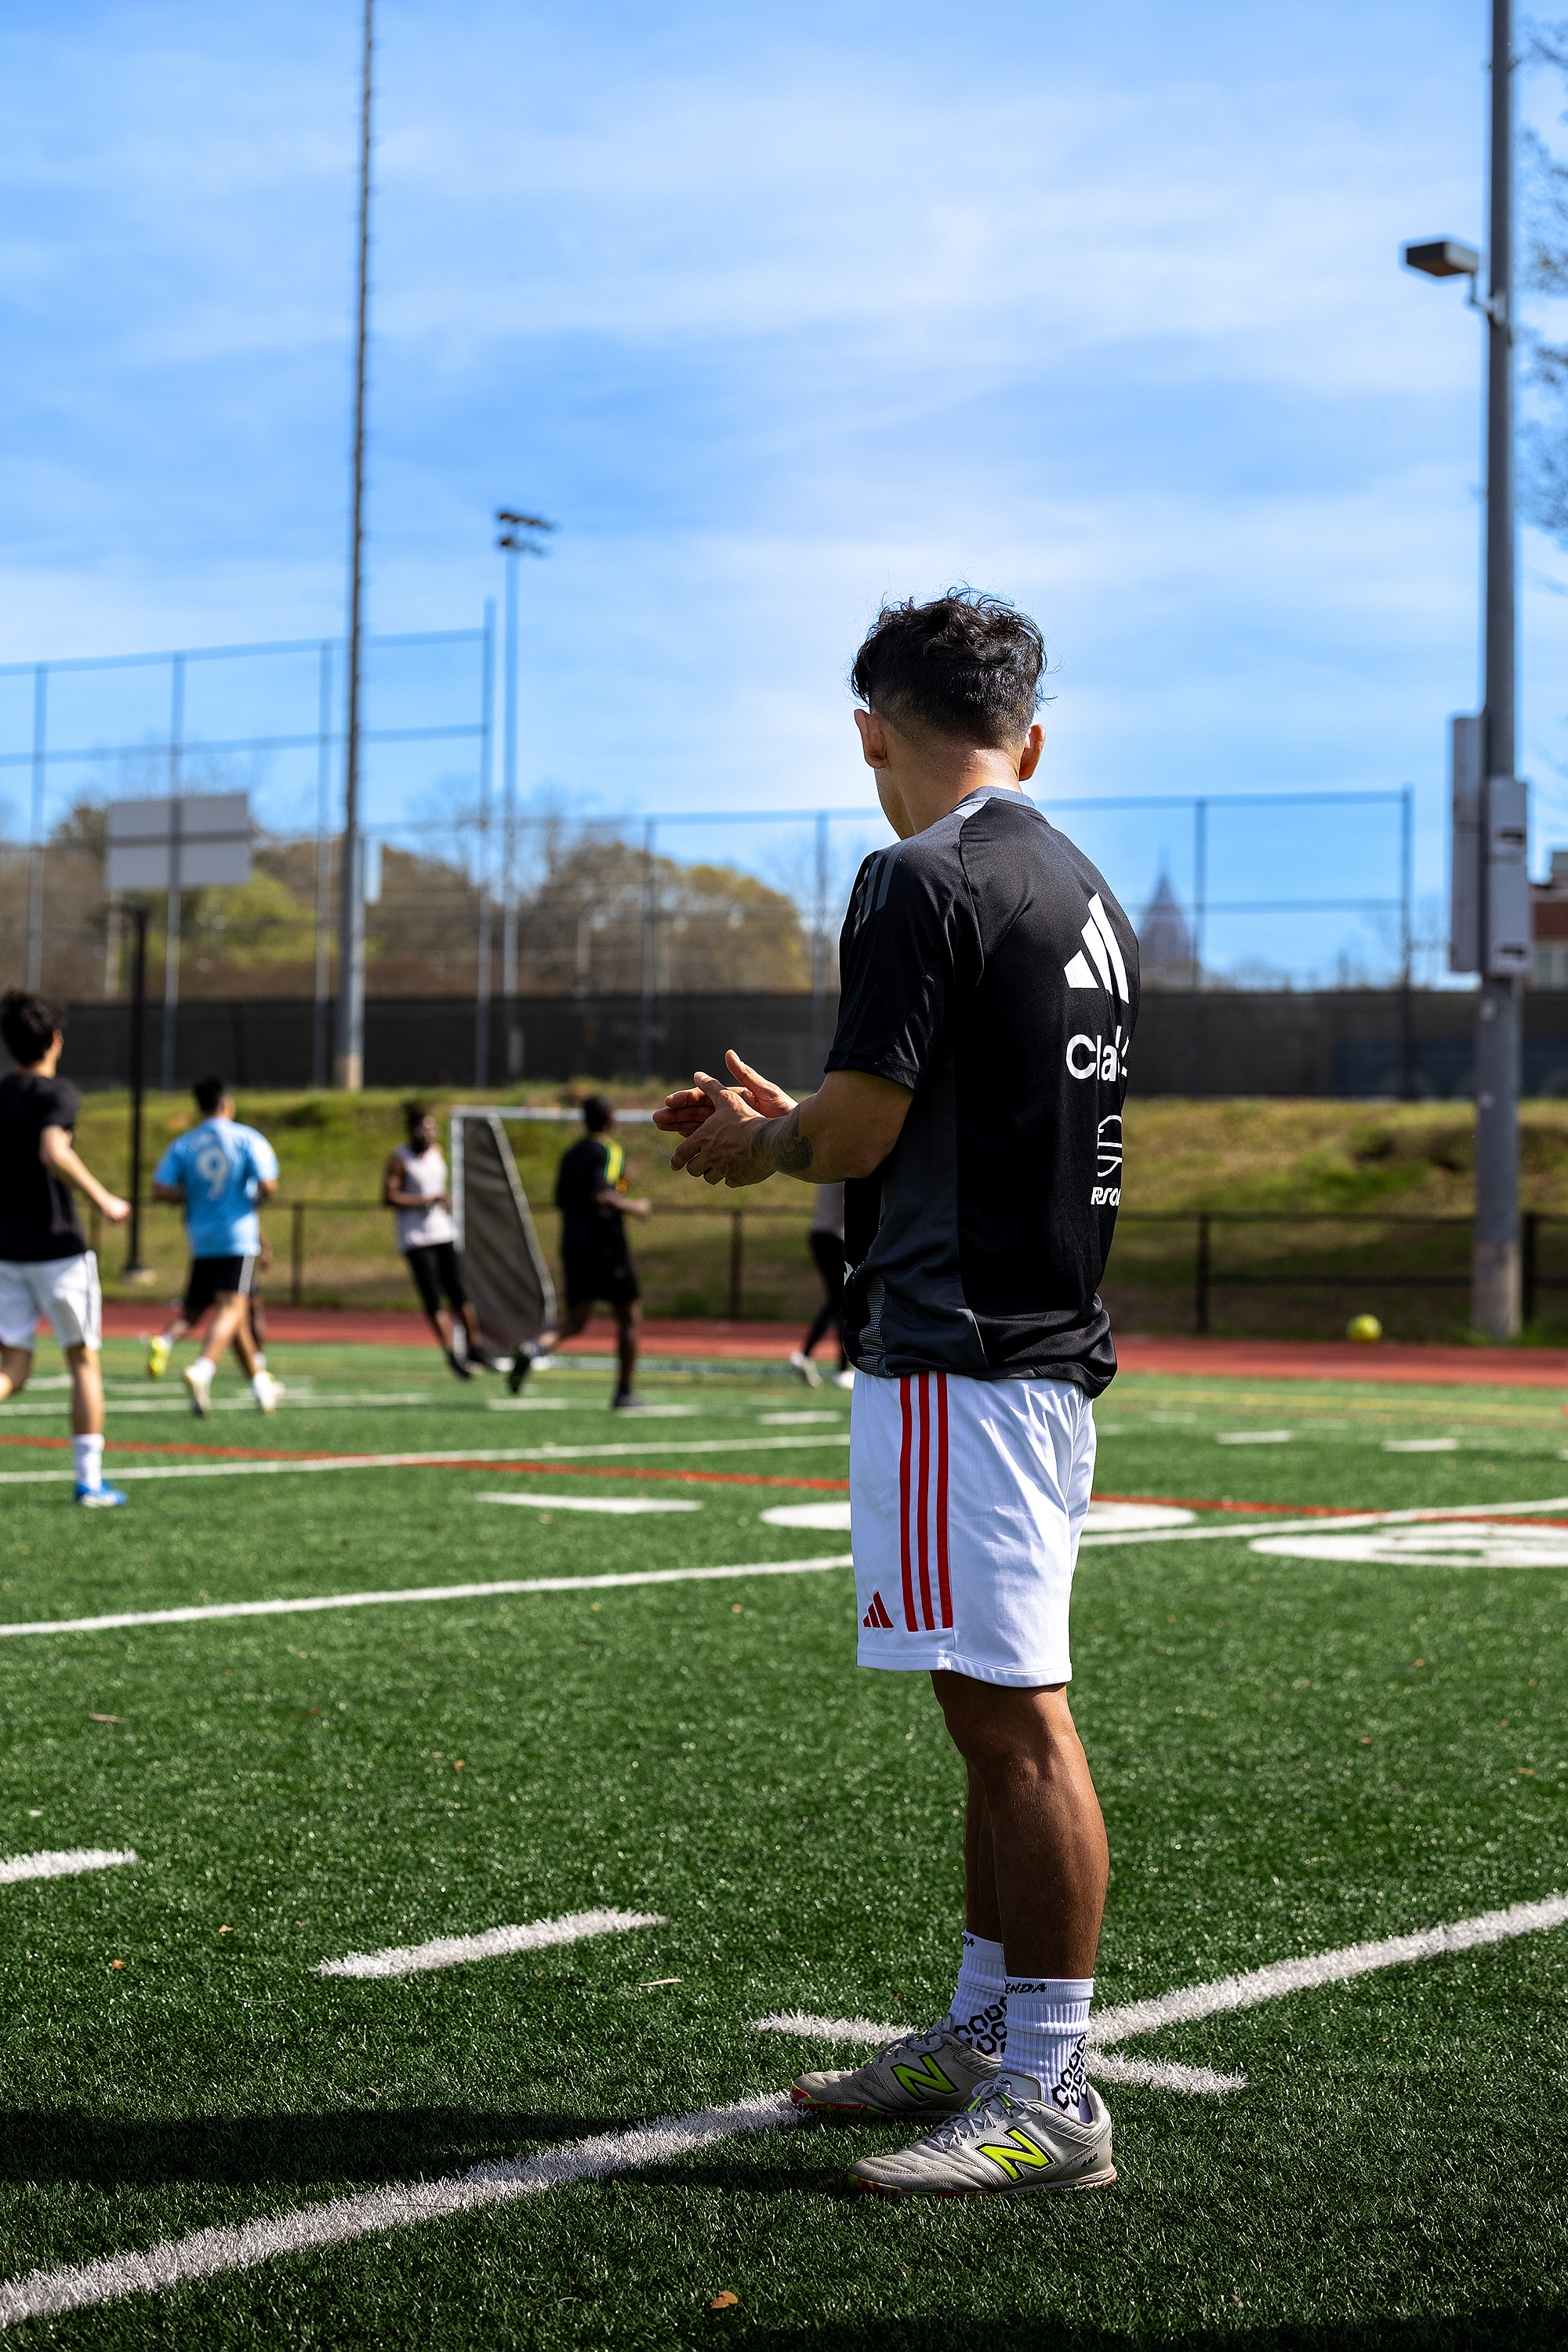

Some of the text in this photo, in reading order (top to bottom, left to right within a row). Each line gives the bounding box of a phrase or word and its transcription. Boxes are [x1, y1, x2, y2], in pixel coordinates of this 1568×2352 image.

[197, 1148, 228, 1200] 9
[1004, 1980, 1047, 1994] ENDA
[891, 2053, 959, 2103] N
[975, 2123, 1054, 2182] N
